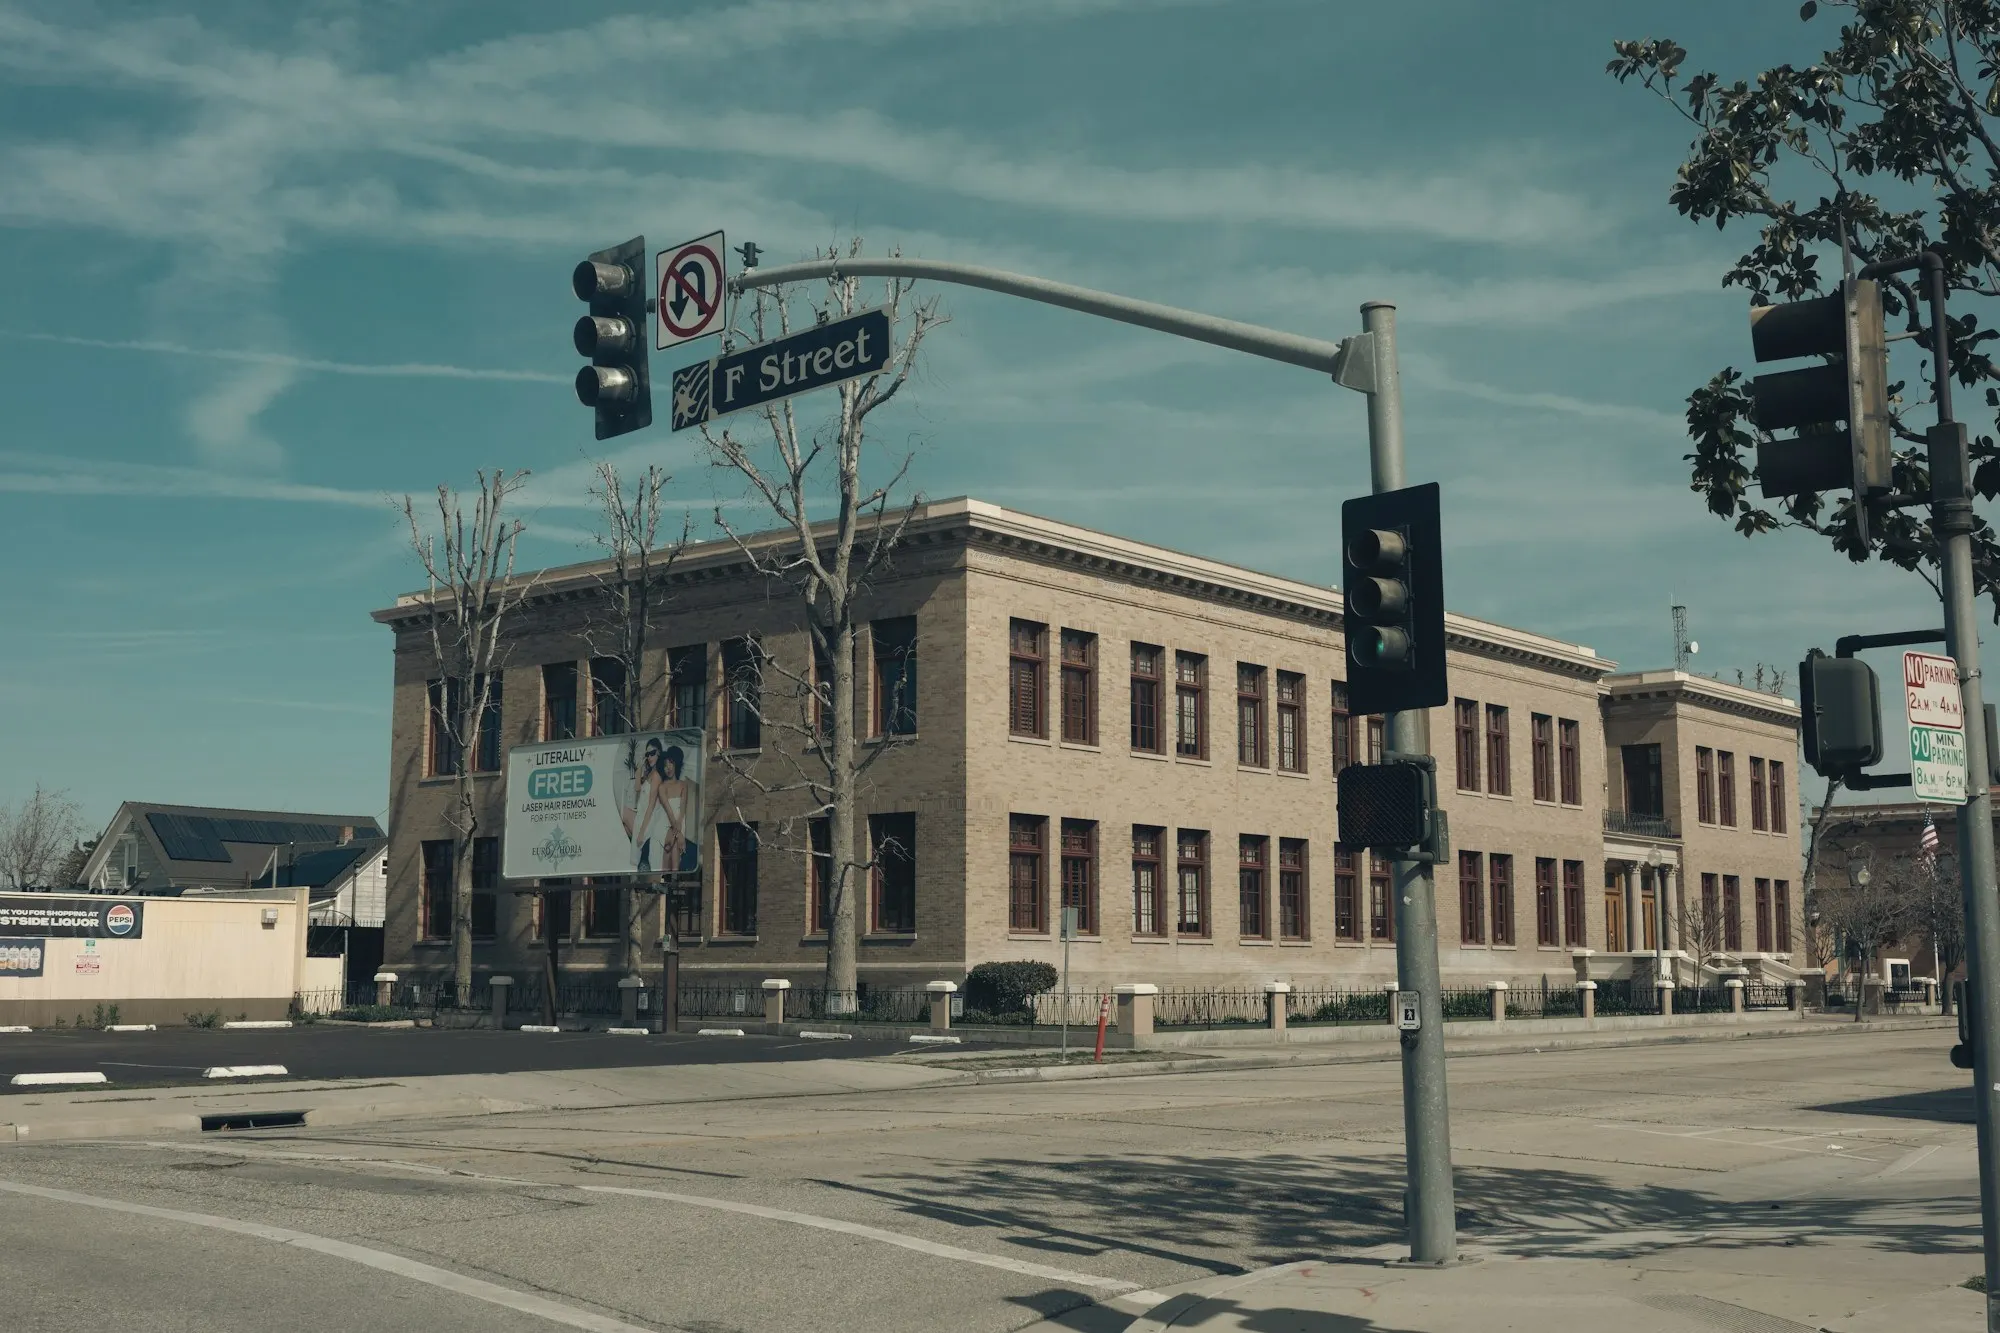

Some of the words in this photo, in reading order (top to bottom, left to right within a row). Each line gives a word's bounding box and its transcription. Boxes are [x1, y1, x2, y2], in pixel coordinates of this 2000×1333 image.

[724, 364, 745, 403] F
[759, 327, 873, 393] Street
[1906, 655, 1923, 684] NO
[1924, 664, 1957, 686] PARKING
[1912, 729, 1930, 758] 90
[1936, 733, 1957, 747] MIN.
[536, 748, 586, 766] LITERALLY
[1932, 746, 1964, 767] PARKING
[534, 770, 585, 796] FREE
[522, 803, 543, 812] LASER
[544, 800, 561, 811] HAIR
[562, 798, 597, 809] REMOVAL
[530, 814, 544, 823] FOR
[544, 812, 562, 822] FIRST
[563, 811, 587, 821] TIMERS
[51, 917, 99, 927] LIQUOR
